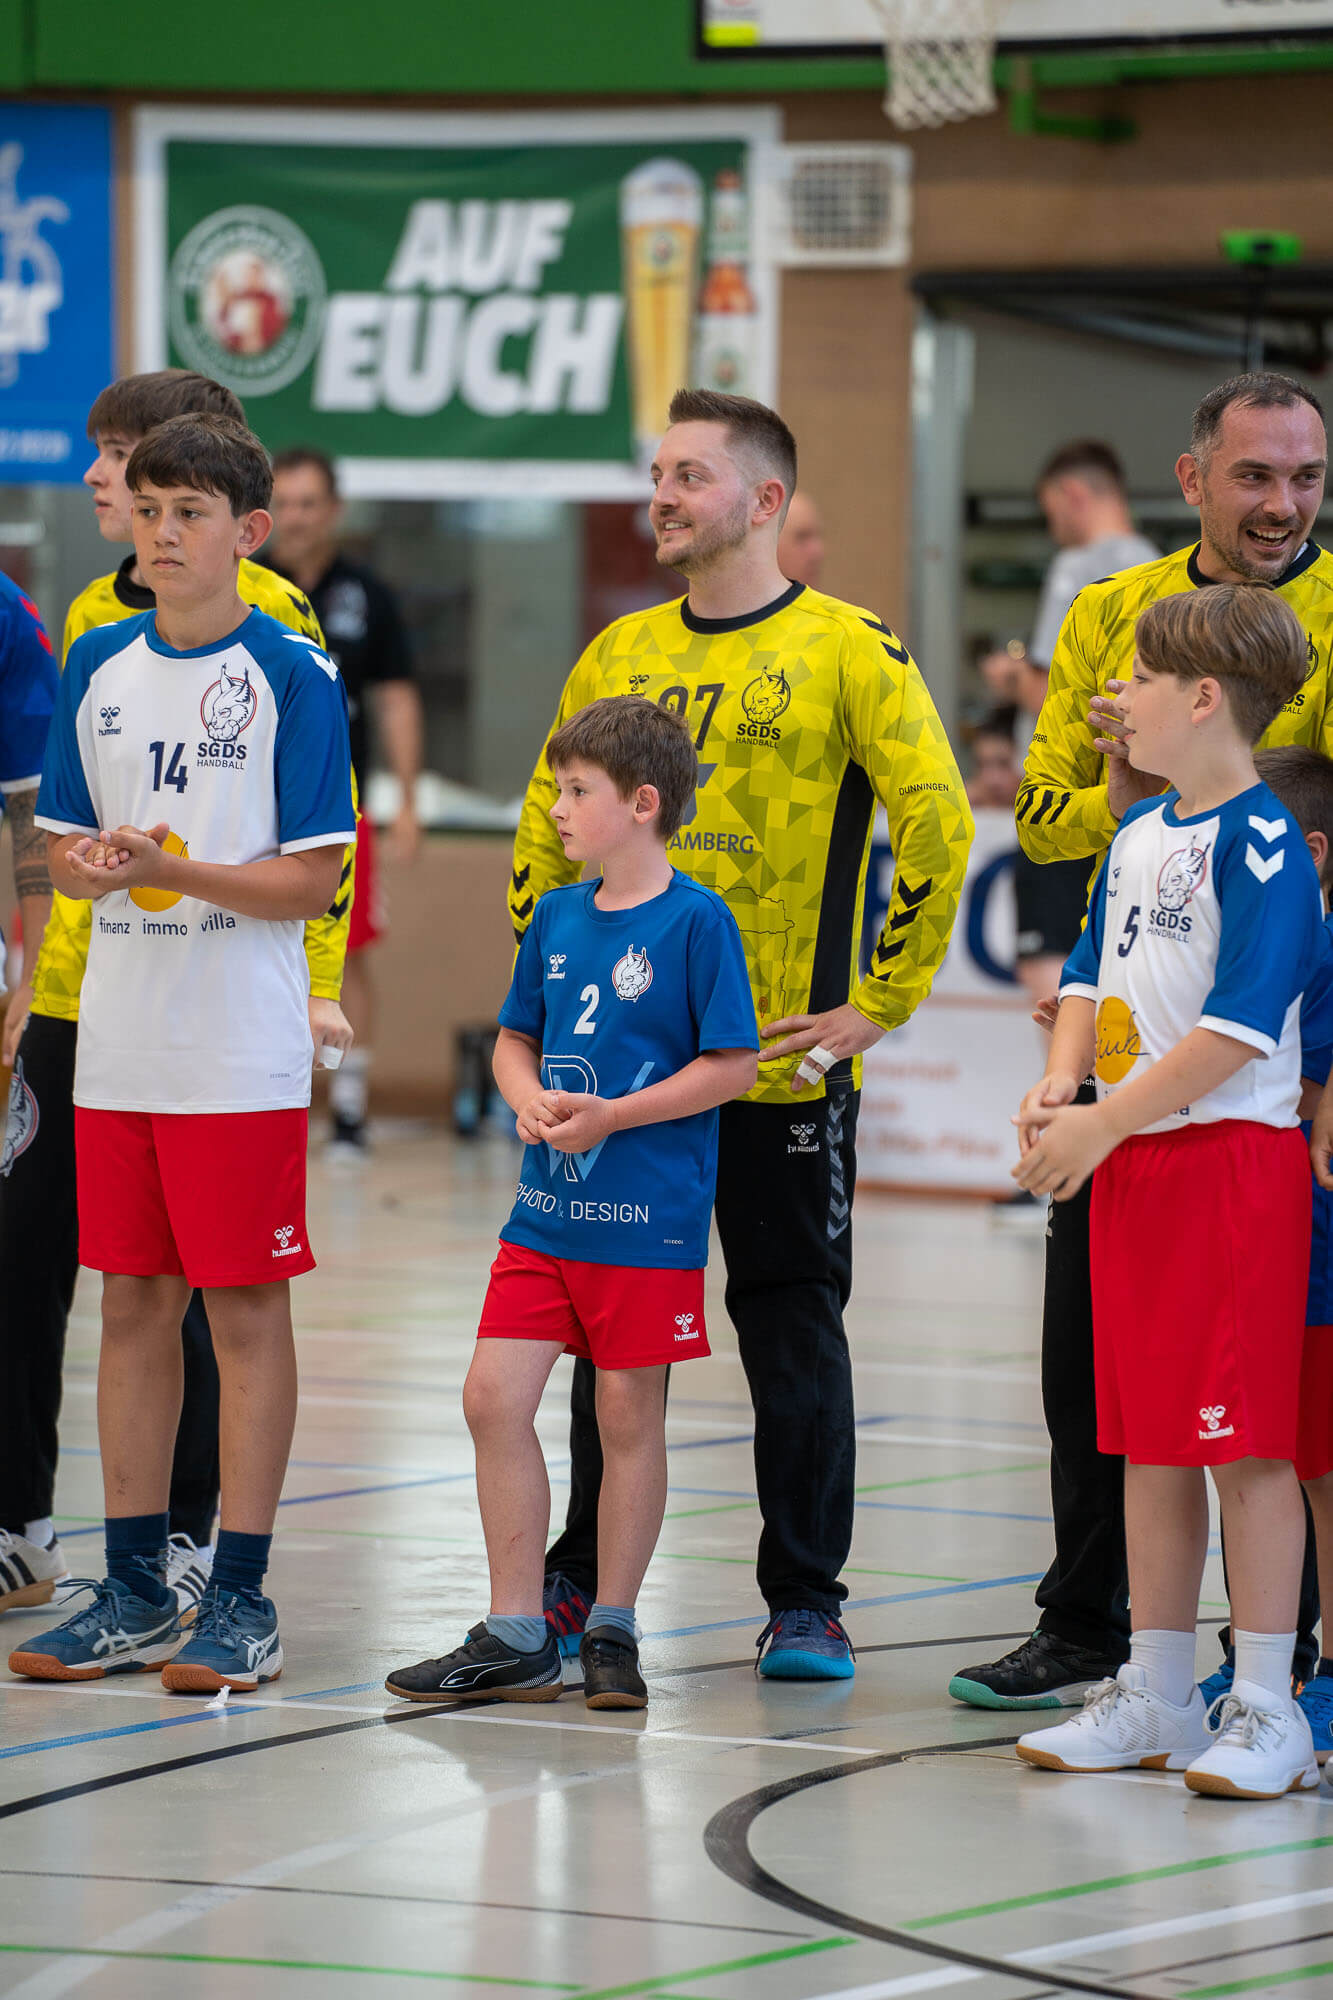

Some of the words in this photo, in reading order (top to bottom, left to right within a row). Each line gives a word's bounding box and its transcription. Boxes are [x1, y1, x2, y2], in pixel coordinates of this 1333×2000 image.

[384, 198, 574, 292] AUF
[312, 293, 625, 418] EUCH
[98, 726, 122, 736] hummel
[736, 723, 782, 741] SGDS
[197, 742, 248, 760] SGDS
[735, 737, 780, 749] HANDBALL
[148, 741, 188, 794] 14
[196, 759, 246, 770] HANDBALL
[898, 782, 950, 796] DUNNINGEN
[665, 831, 755, 855] AMBERG
[99, 916, 131, 935] finanz
[143, 918, 189, 936] immo
[200, 912, 237, 933] villa
[1118, 905, 1140, 957] 5
[1149, 908, 1193, 933] SGDS
[1145, 927, 1191, 944] HANDBALL
[573, 983, 600, 1035] 2
[516, 1182, 557, 1213] PHOTO
[570, 1200, 649, 1224] DESIGN
[272, 1243, 302, 1258] hummel
[673, 1329, 700, 1342] hummel
